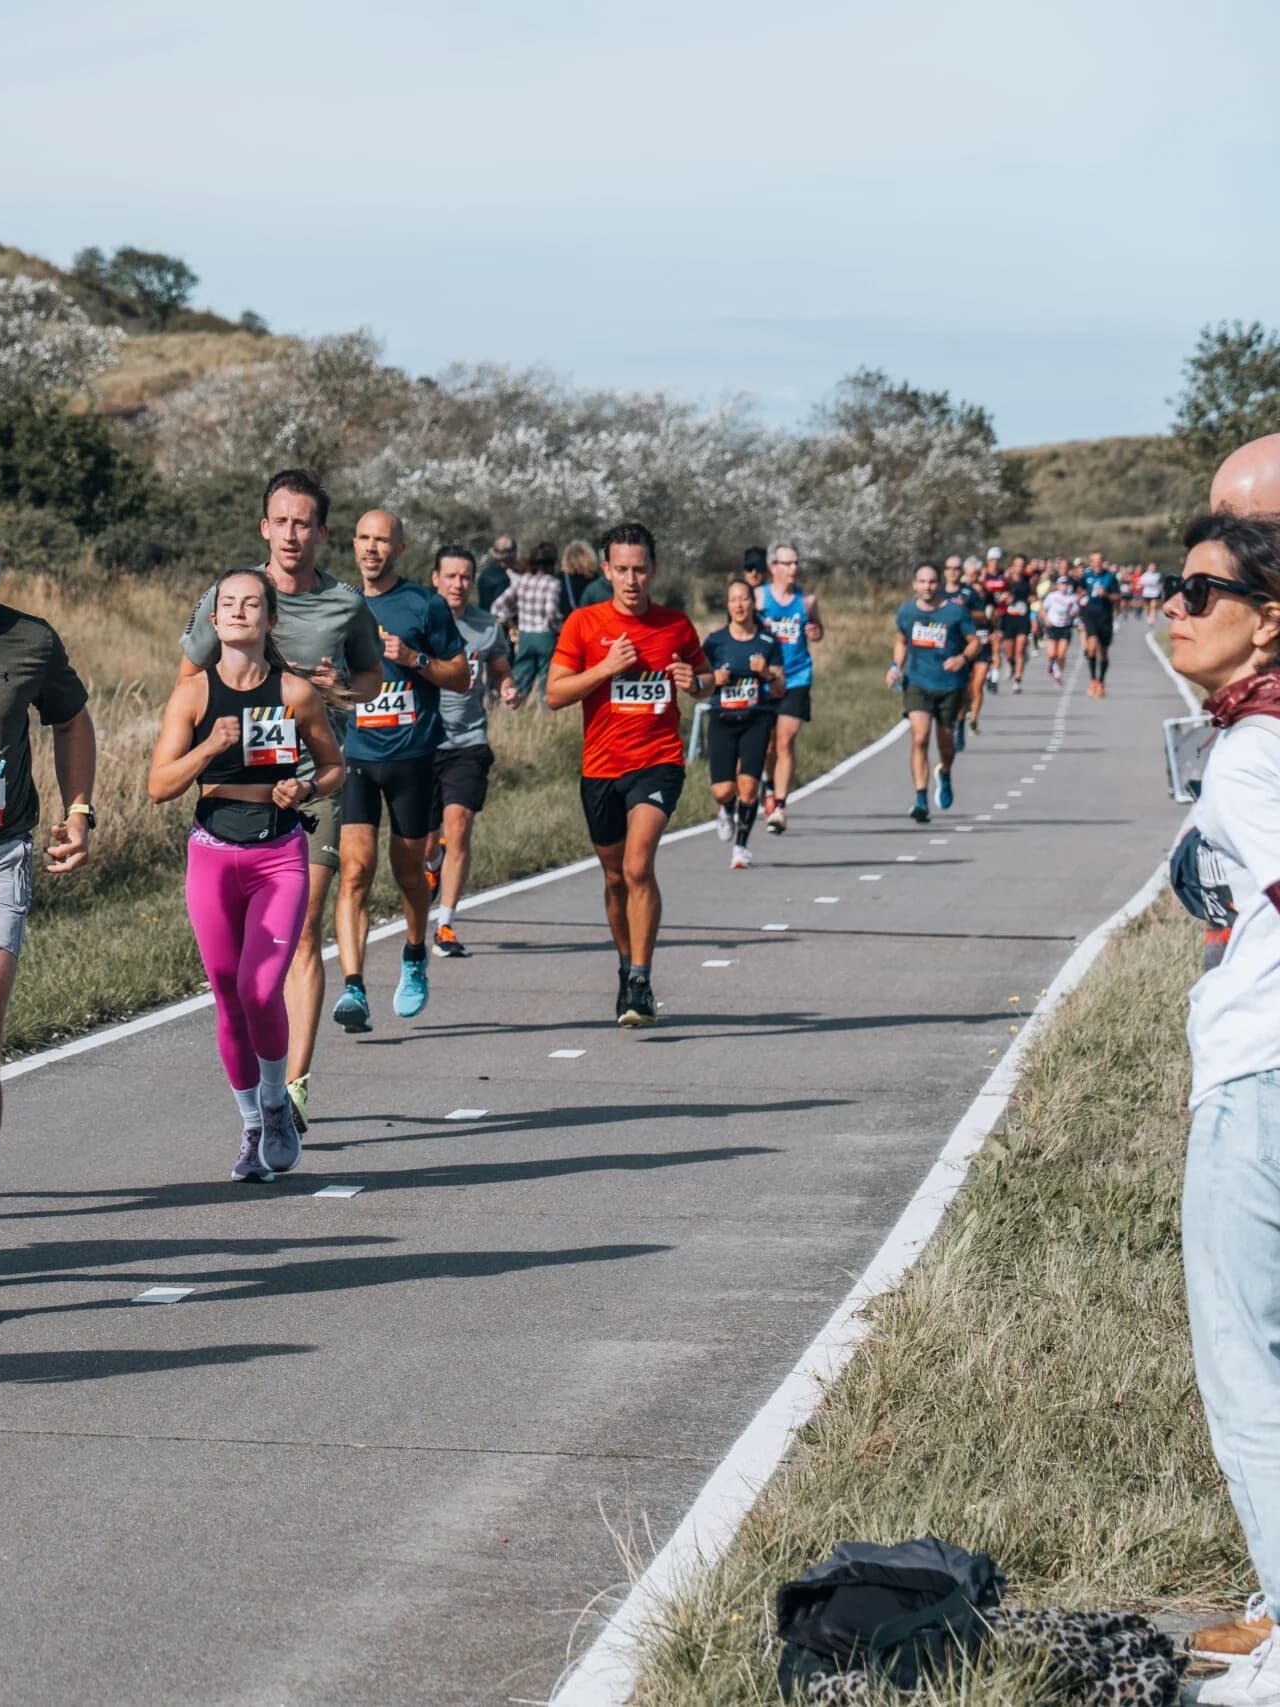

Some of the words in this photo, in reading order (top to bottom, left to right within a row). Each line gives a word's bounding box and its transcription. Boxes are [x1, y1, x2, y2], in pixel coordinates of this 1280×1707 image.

[615, 683, 666, 701] 1439
[364, 695, 406, 713] 644
[248, 724, 285, 747] 24
